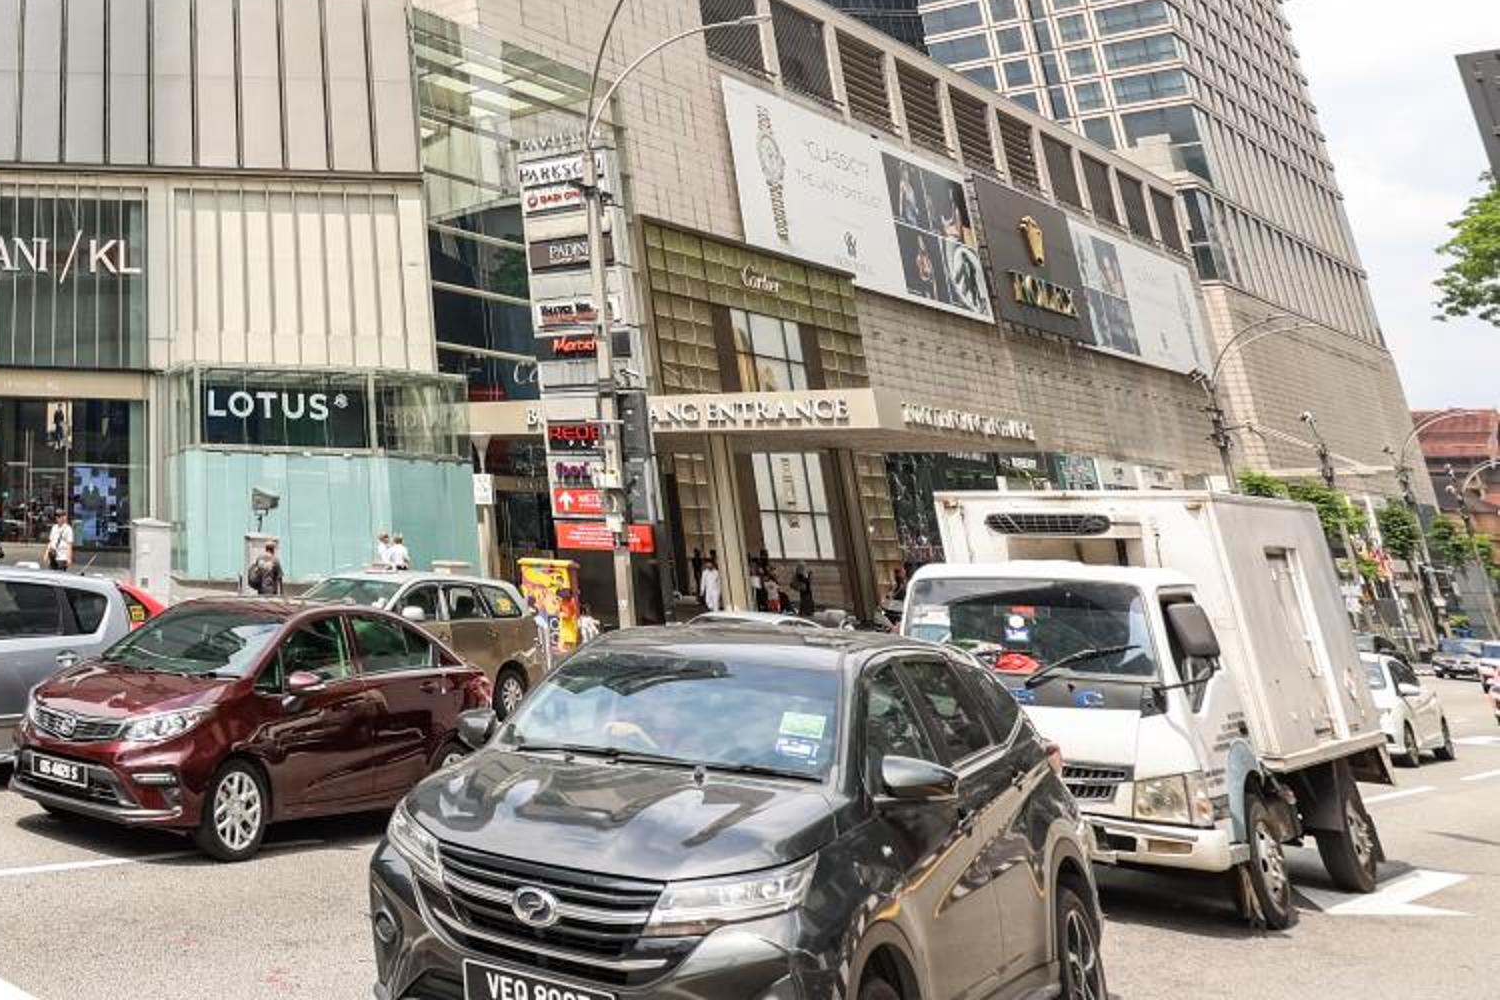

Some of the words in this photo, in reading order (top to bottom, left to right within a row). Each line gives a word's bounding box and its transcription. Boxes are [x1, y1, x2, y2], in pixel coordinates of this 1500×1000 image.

[89, 238, 142, 274] KL
[207, 389, 329, 420] LOTUS
[706, 400, 851, 424] ENTRANCE
